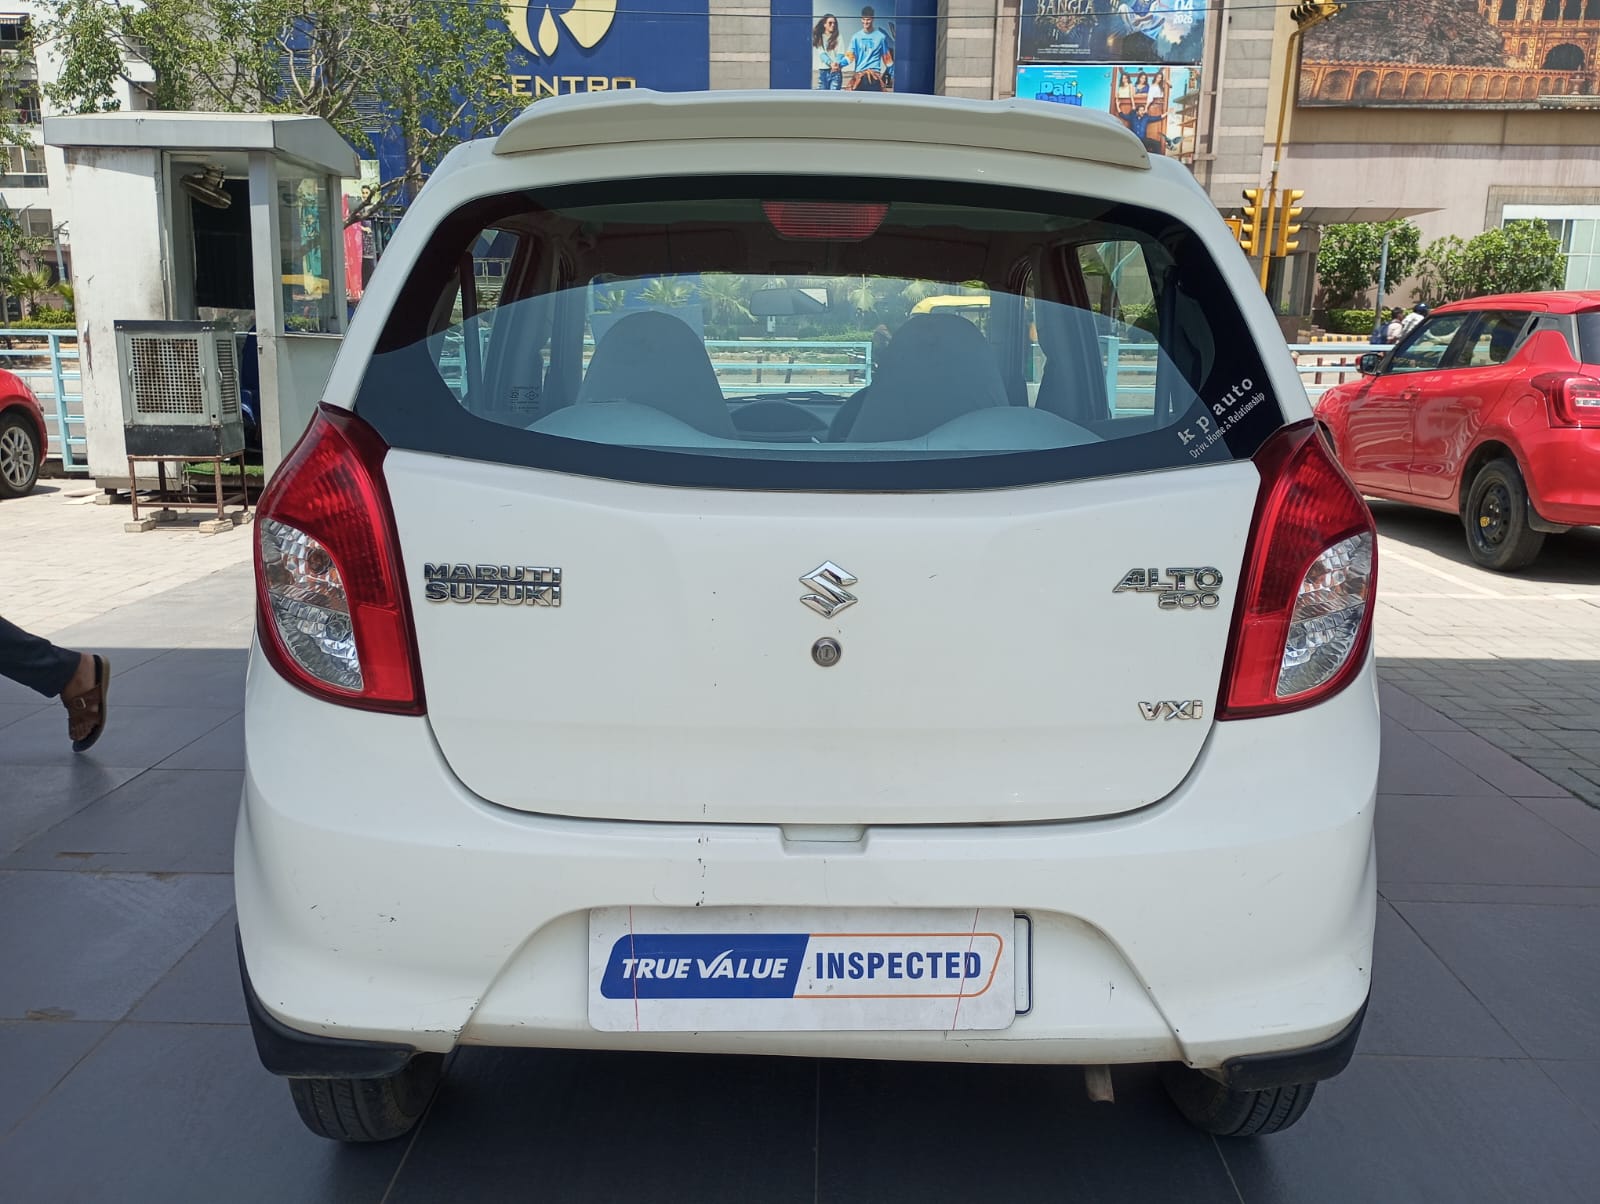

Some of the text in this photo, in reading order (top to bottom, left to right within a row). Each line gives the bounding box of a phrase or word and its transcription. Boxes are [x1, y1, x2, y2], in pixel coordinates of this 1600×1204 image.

[1040, 81, 1078, 96] Pati
[1196, 416, 1210, 433] p
[1213, 378, 1253, 415] auto
[1189, 441, 1209, 458] Drive
[1206, 426, 1226, 445] Home
[1228, 392, 1265, 423] Relationship
[424, 563, 562, 583] MARUTI
[1112, 567, 1223, 593] ALTO
[425, 582, 561, 606] SUZUKI
[1158, 592, 1220, 609] 800
[622, 949, 981, 979] TRUE VALUE INSPECTED
